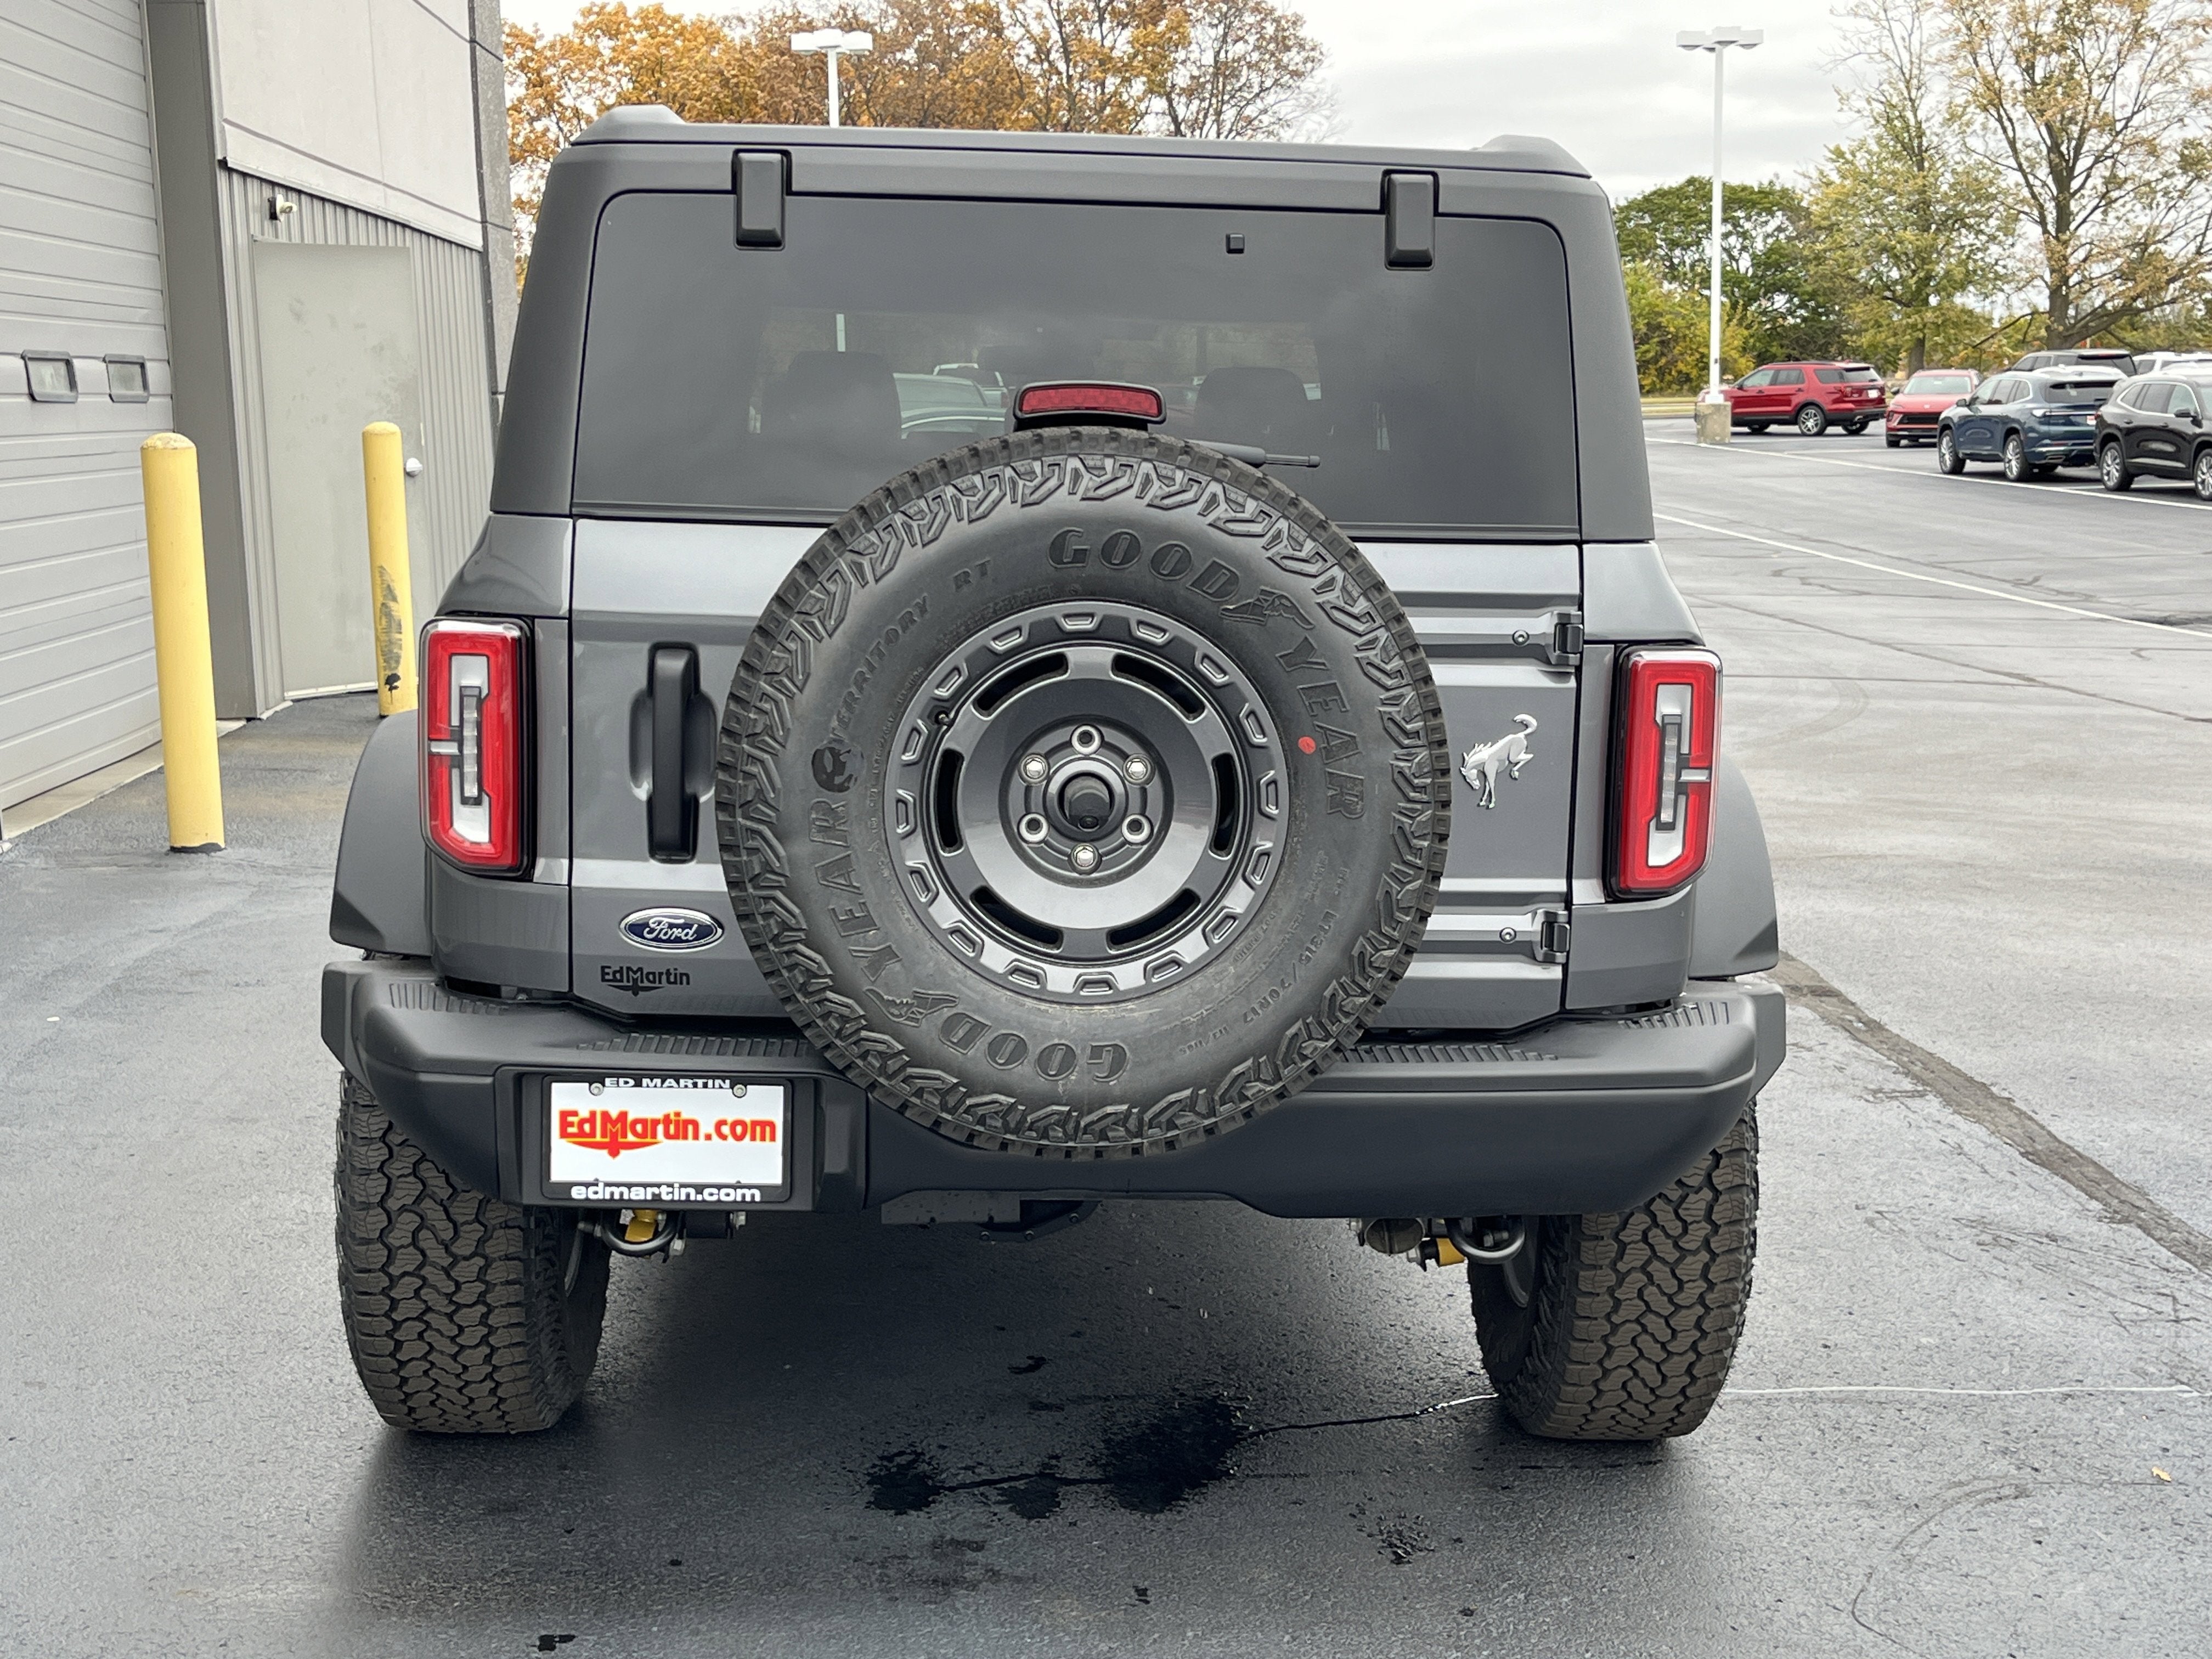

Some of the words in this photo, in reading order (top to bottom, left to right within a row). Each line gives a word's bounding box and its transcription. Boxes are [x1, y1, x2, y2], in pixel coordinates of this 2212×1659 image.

[830, 593, 929, 740] TERRITORY
[953, 558, 991, 592] RT
[643, 917, 698, 940] Ford
[600, 965, 691, 986] EdMartin
[1243, 910, 1339, 1025] LT315/70R17
[604, 1077, 635, 1088] ED
[642, 1078, 731, 1089] MARTIN
[558, 1109, 777, 1143] EdMartin.com
[571, 1182, 761, 1202] edmartin.com
